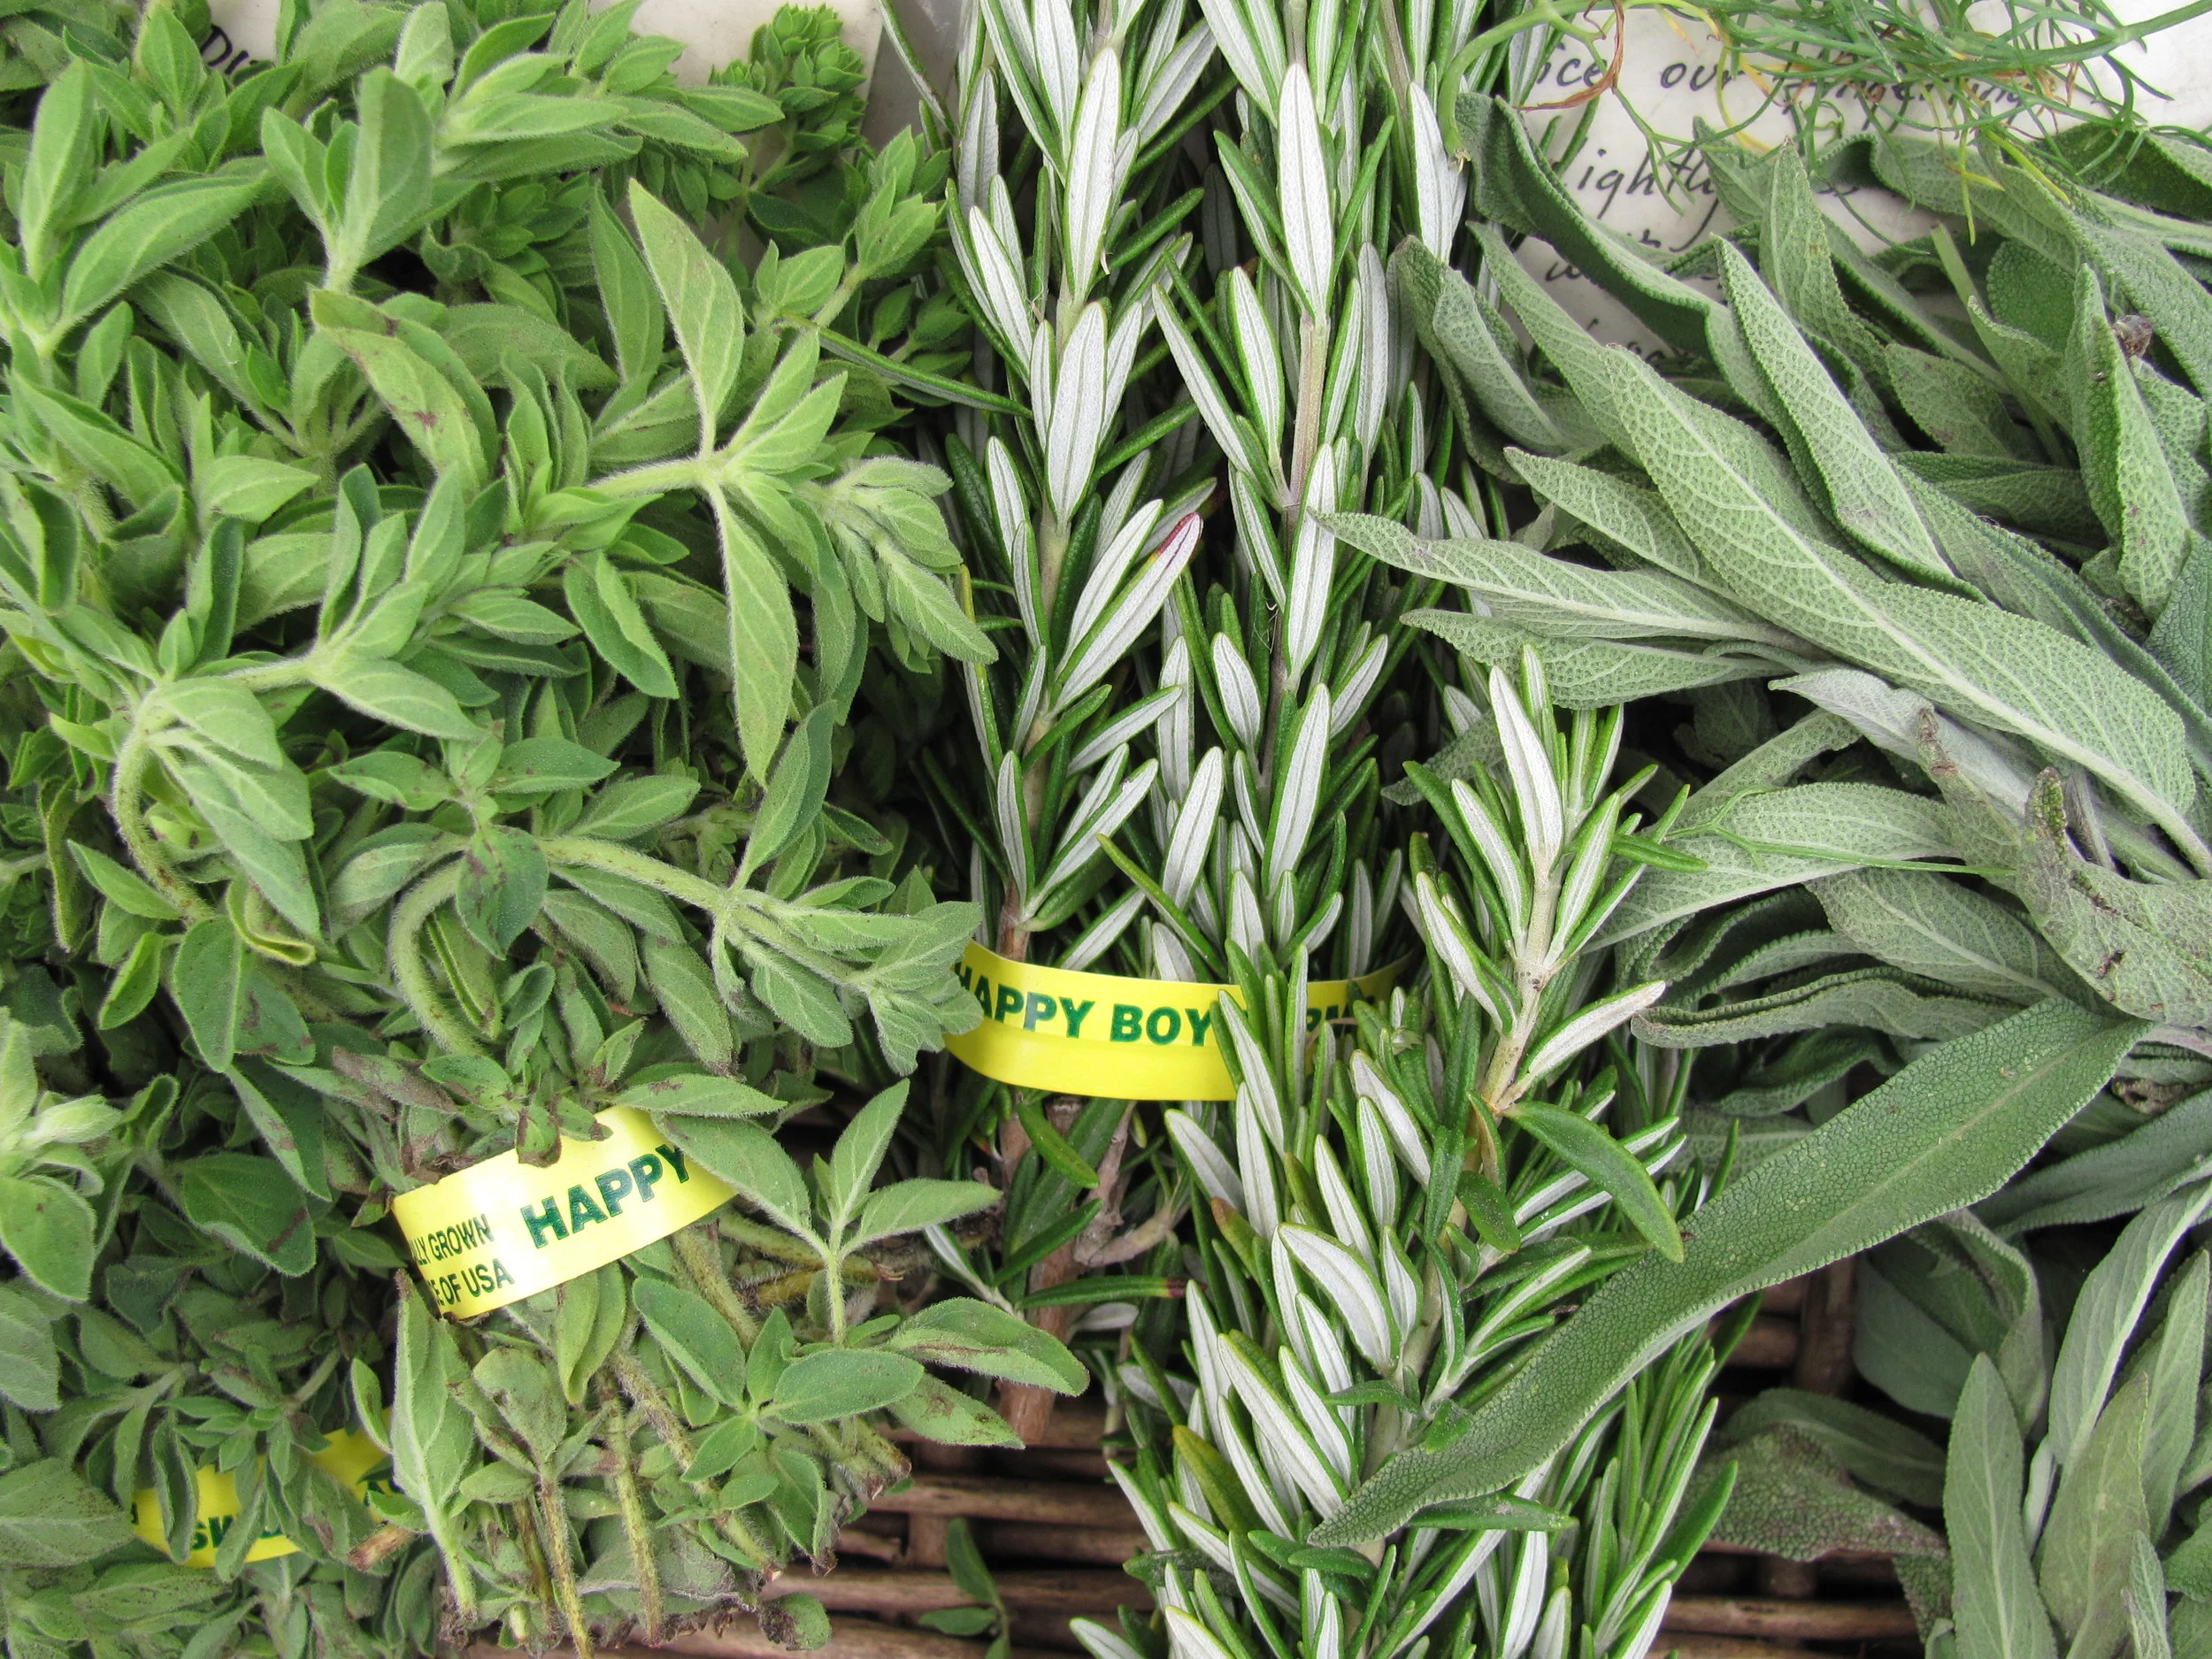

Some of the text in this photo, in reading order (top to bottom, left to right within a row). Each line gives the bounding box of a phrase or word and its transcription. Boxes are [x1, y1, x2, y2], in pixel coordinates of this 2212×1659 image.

[1578, 147, 1719, 252] ightly
[1110, 1002, 1213, 1047] BOY
[520, 1144, 690, 1249] HAPPY
[427, 1213, 495, 1261] GROWN
[439, 1273, 462, 1305] OF
[461, 1258, 515, 1298] USA
